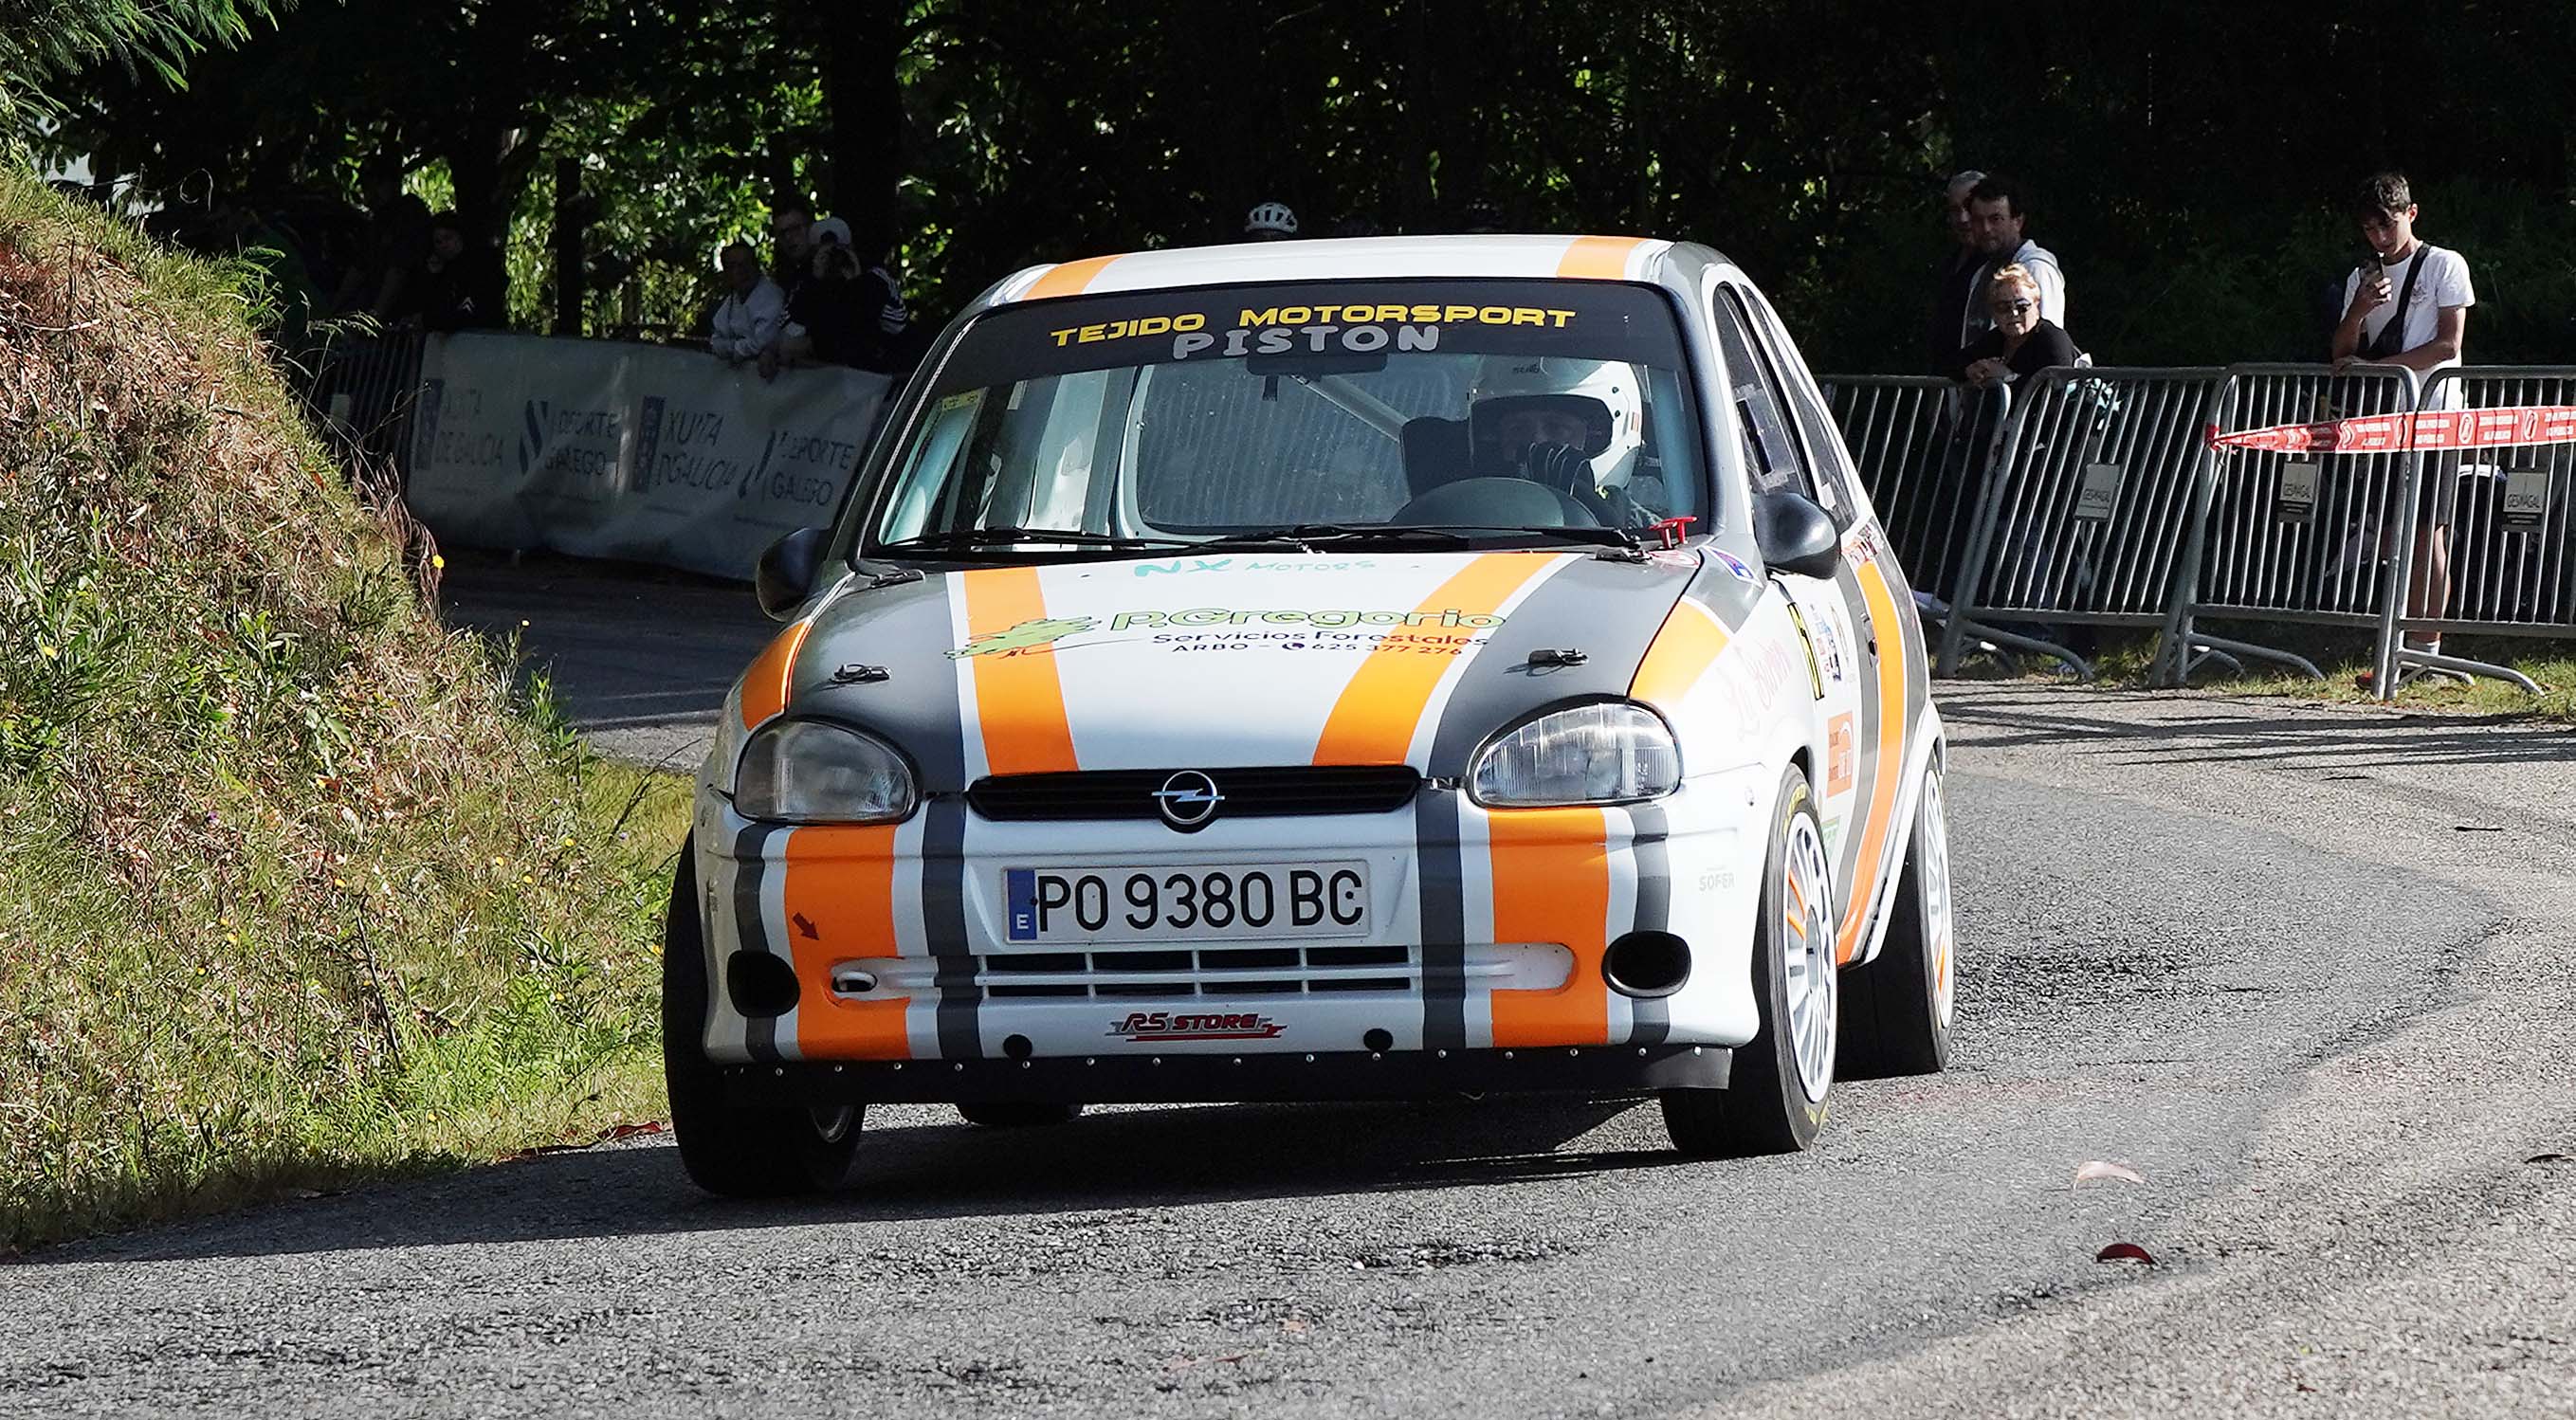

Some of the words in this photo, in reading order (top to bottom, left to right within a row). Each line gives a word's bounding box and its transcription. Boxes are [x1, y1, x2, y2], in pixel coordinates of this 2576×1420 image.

[1050, 313, 1205, 347] TEJIDO
[1238, 304, 1578, 330] MOTORSPORT
[1173, 324, 1440, 360] PISTON
[1244, 560, 1378, 573] MOTORS
[1153, 629, 1306, 645] Servicios
[1314, 630, 1489, 646] Forestales
[1172, 642, 1250, 653] ARBO
[1311, 643, 1358, 651] 625
[1366, 644, 1412, 653] 377
[1416, 646, 1464, 657] 276
[1037, 874, 1109, 932] PO
[1124, 870, 1275, 930] 9380
[1289, 869, 1364, 927] BC
[1016, 913, 1029, 930] E
[1122, 1012, 1169, 1032] RS
[1172, 1013, 1259, 1030] STORE
